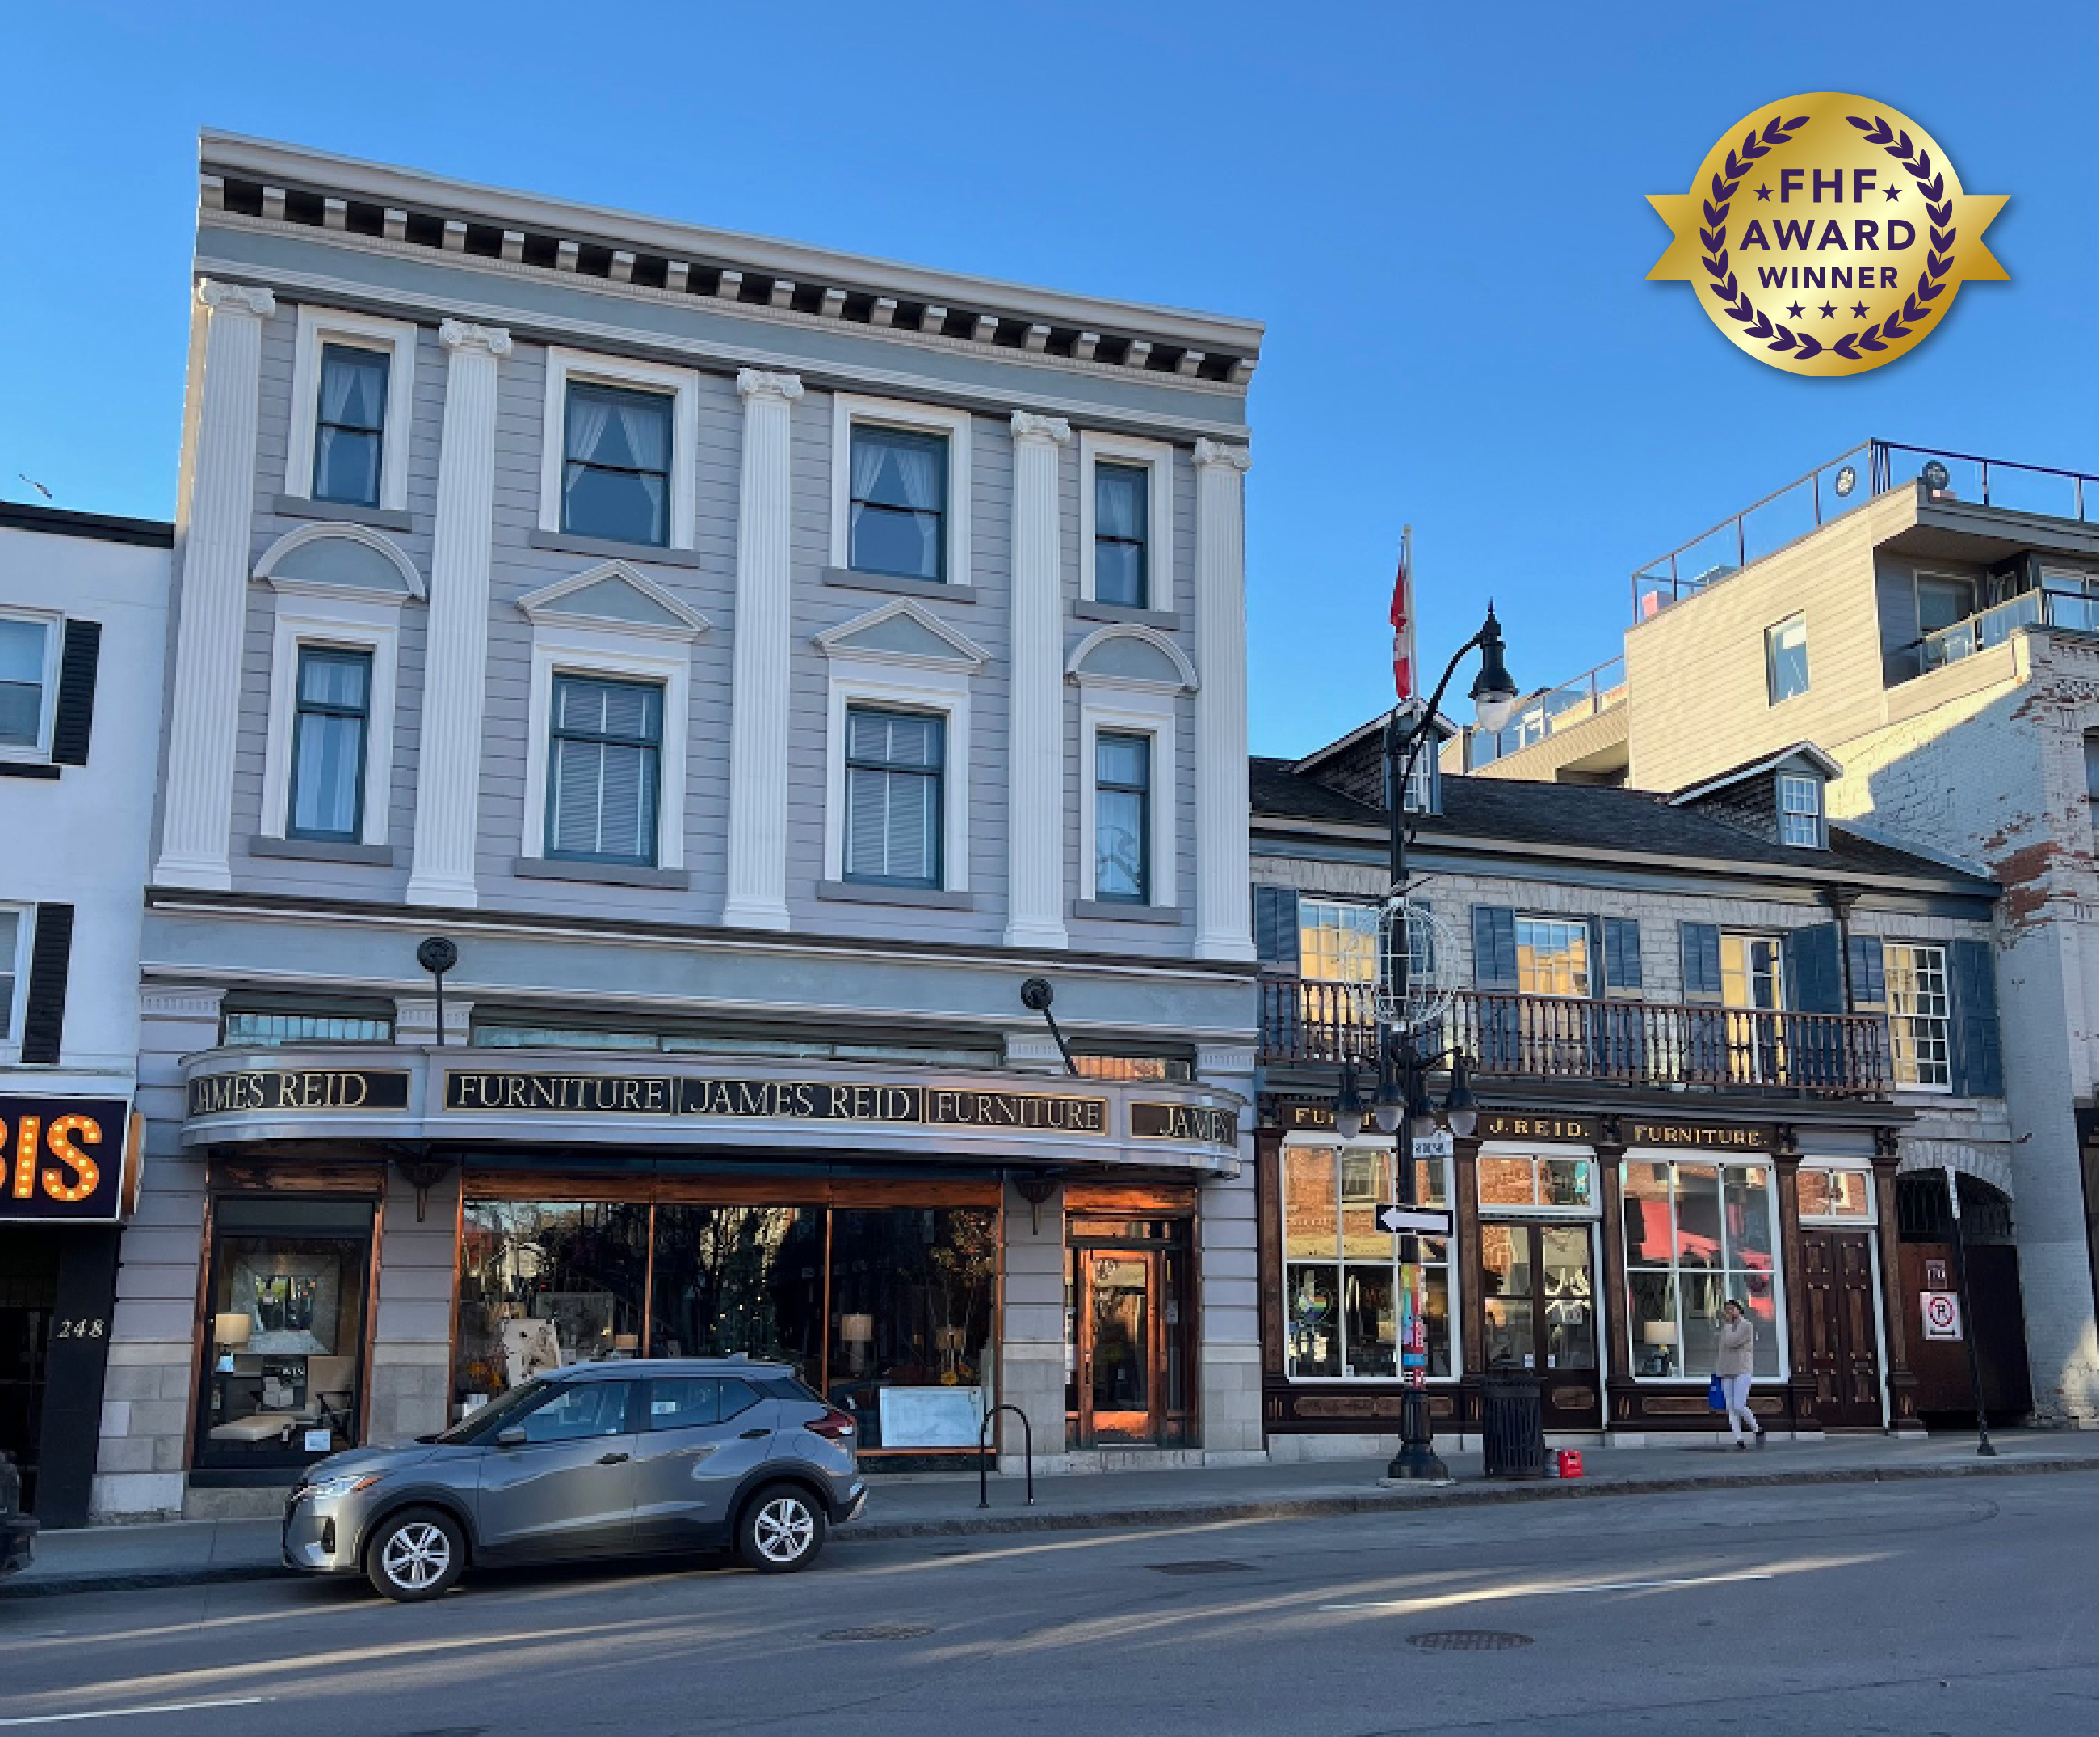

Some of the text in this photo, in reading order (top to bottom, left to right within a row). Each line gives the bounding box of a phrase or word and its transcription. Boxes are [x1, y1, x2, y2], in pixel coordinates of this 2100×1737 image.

[277, 1073, 368, 1107] REID
[457, 1075, 663, 1109] FURNITURE
[690, 1080, 909, 1118] JAMES REID
[935, 1092, 1098, 1129] FURNITURE
[0, 1114, 103, 1201] IS
[57, 1319, 104, 1338] 248
